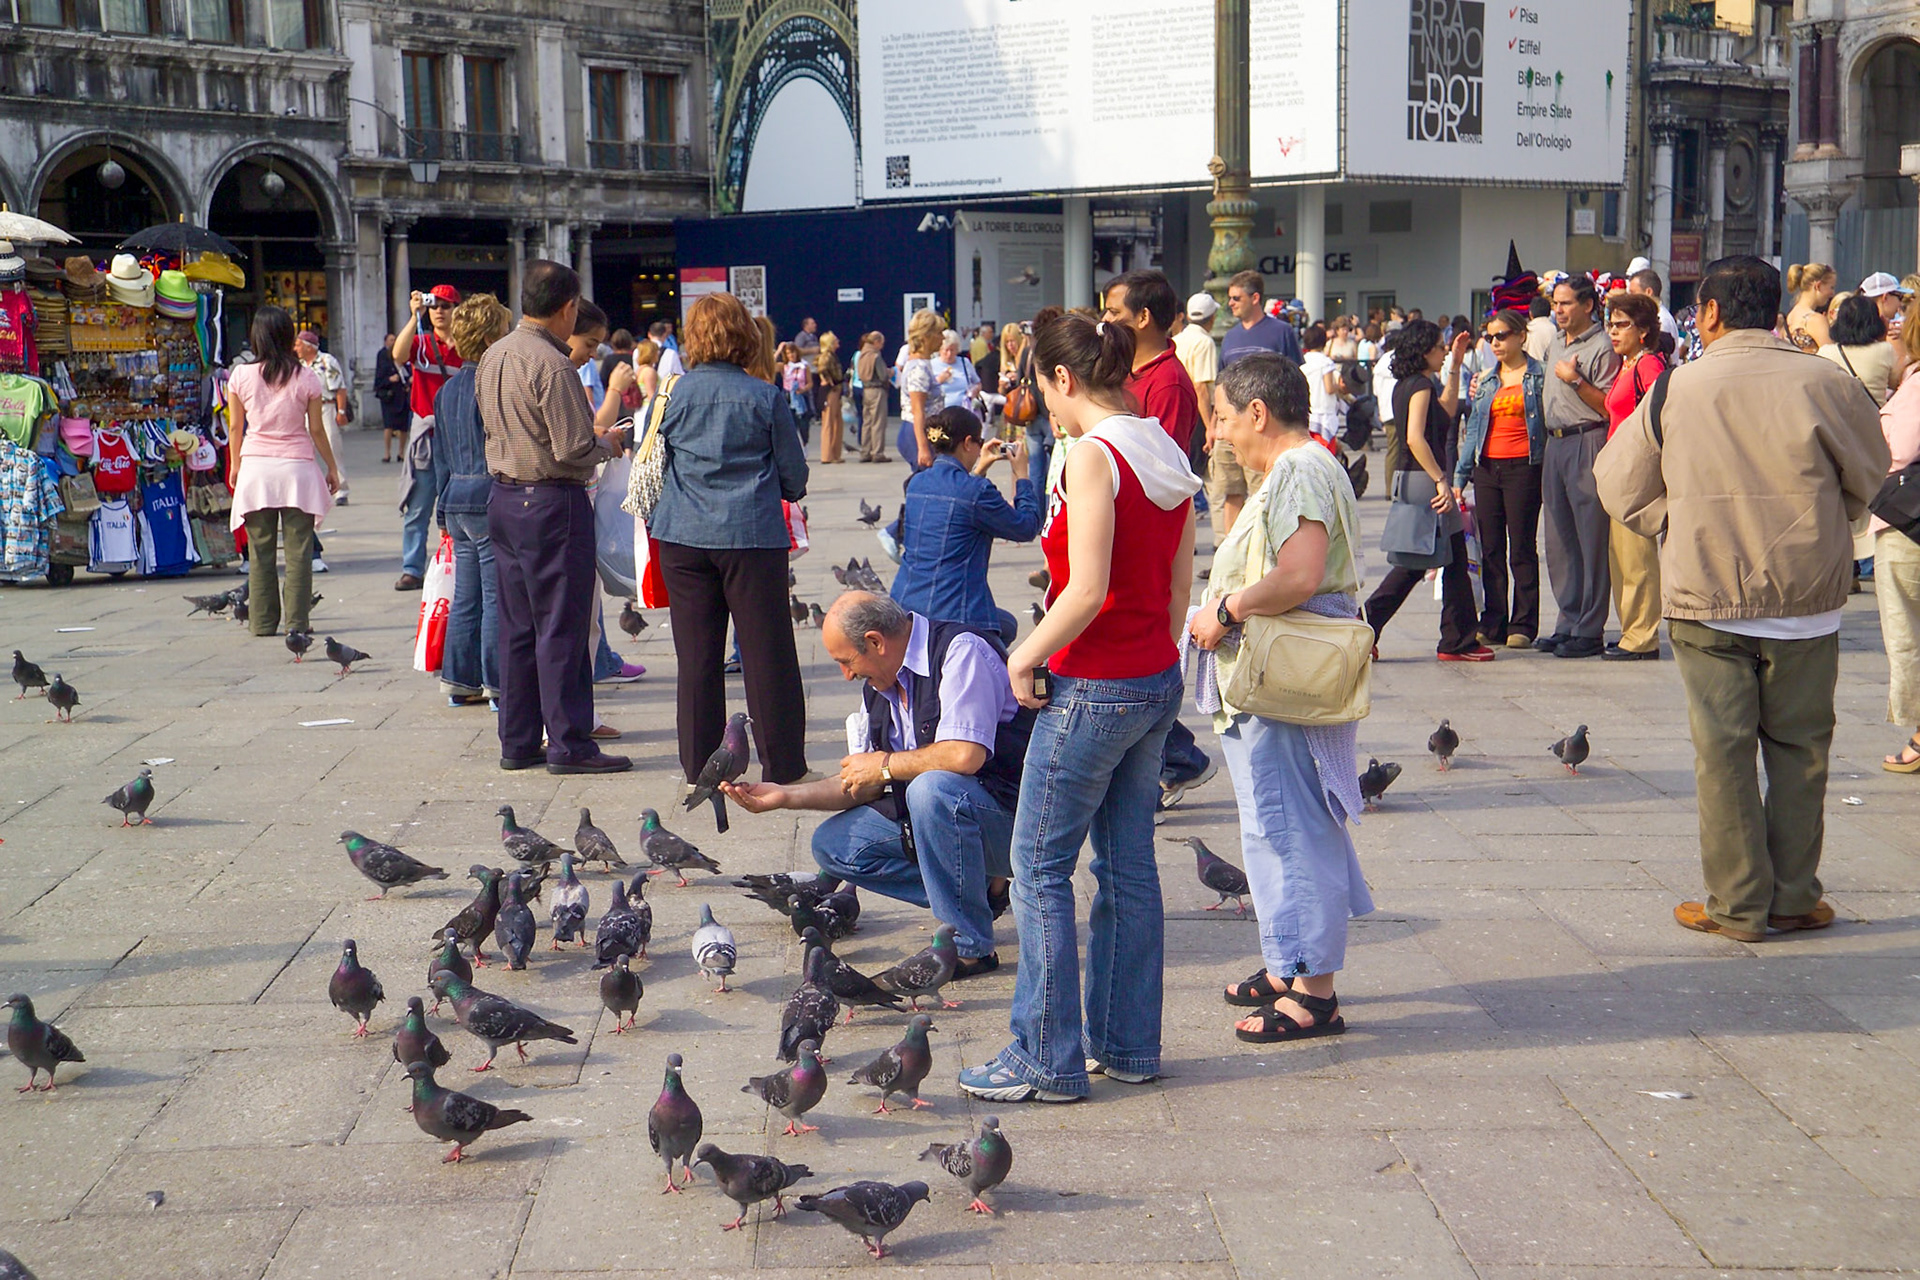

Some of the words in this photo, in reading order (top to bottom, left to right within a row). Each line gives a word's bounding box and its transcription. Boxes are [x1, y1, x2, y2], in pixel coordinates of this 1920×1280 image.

[1520, 8, 1538, 24] Pisa
[1519, 40, 1541, 55] Eiffel
[1535, 72, 1552, 87] Ben
[1517, 102, 1548, 120] Empire
[1550, 104, 1572, 119] State
[1517, 132, 1572, 151] Dell'Orologio
[1258, 252, 1352, 275] CHGE
